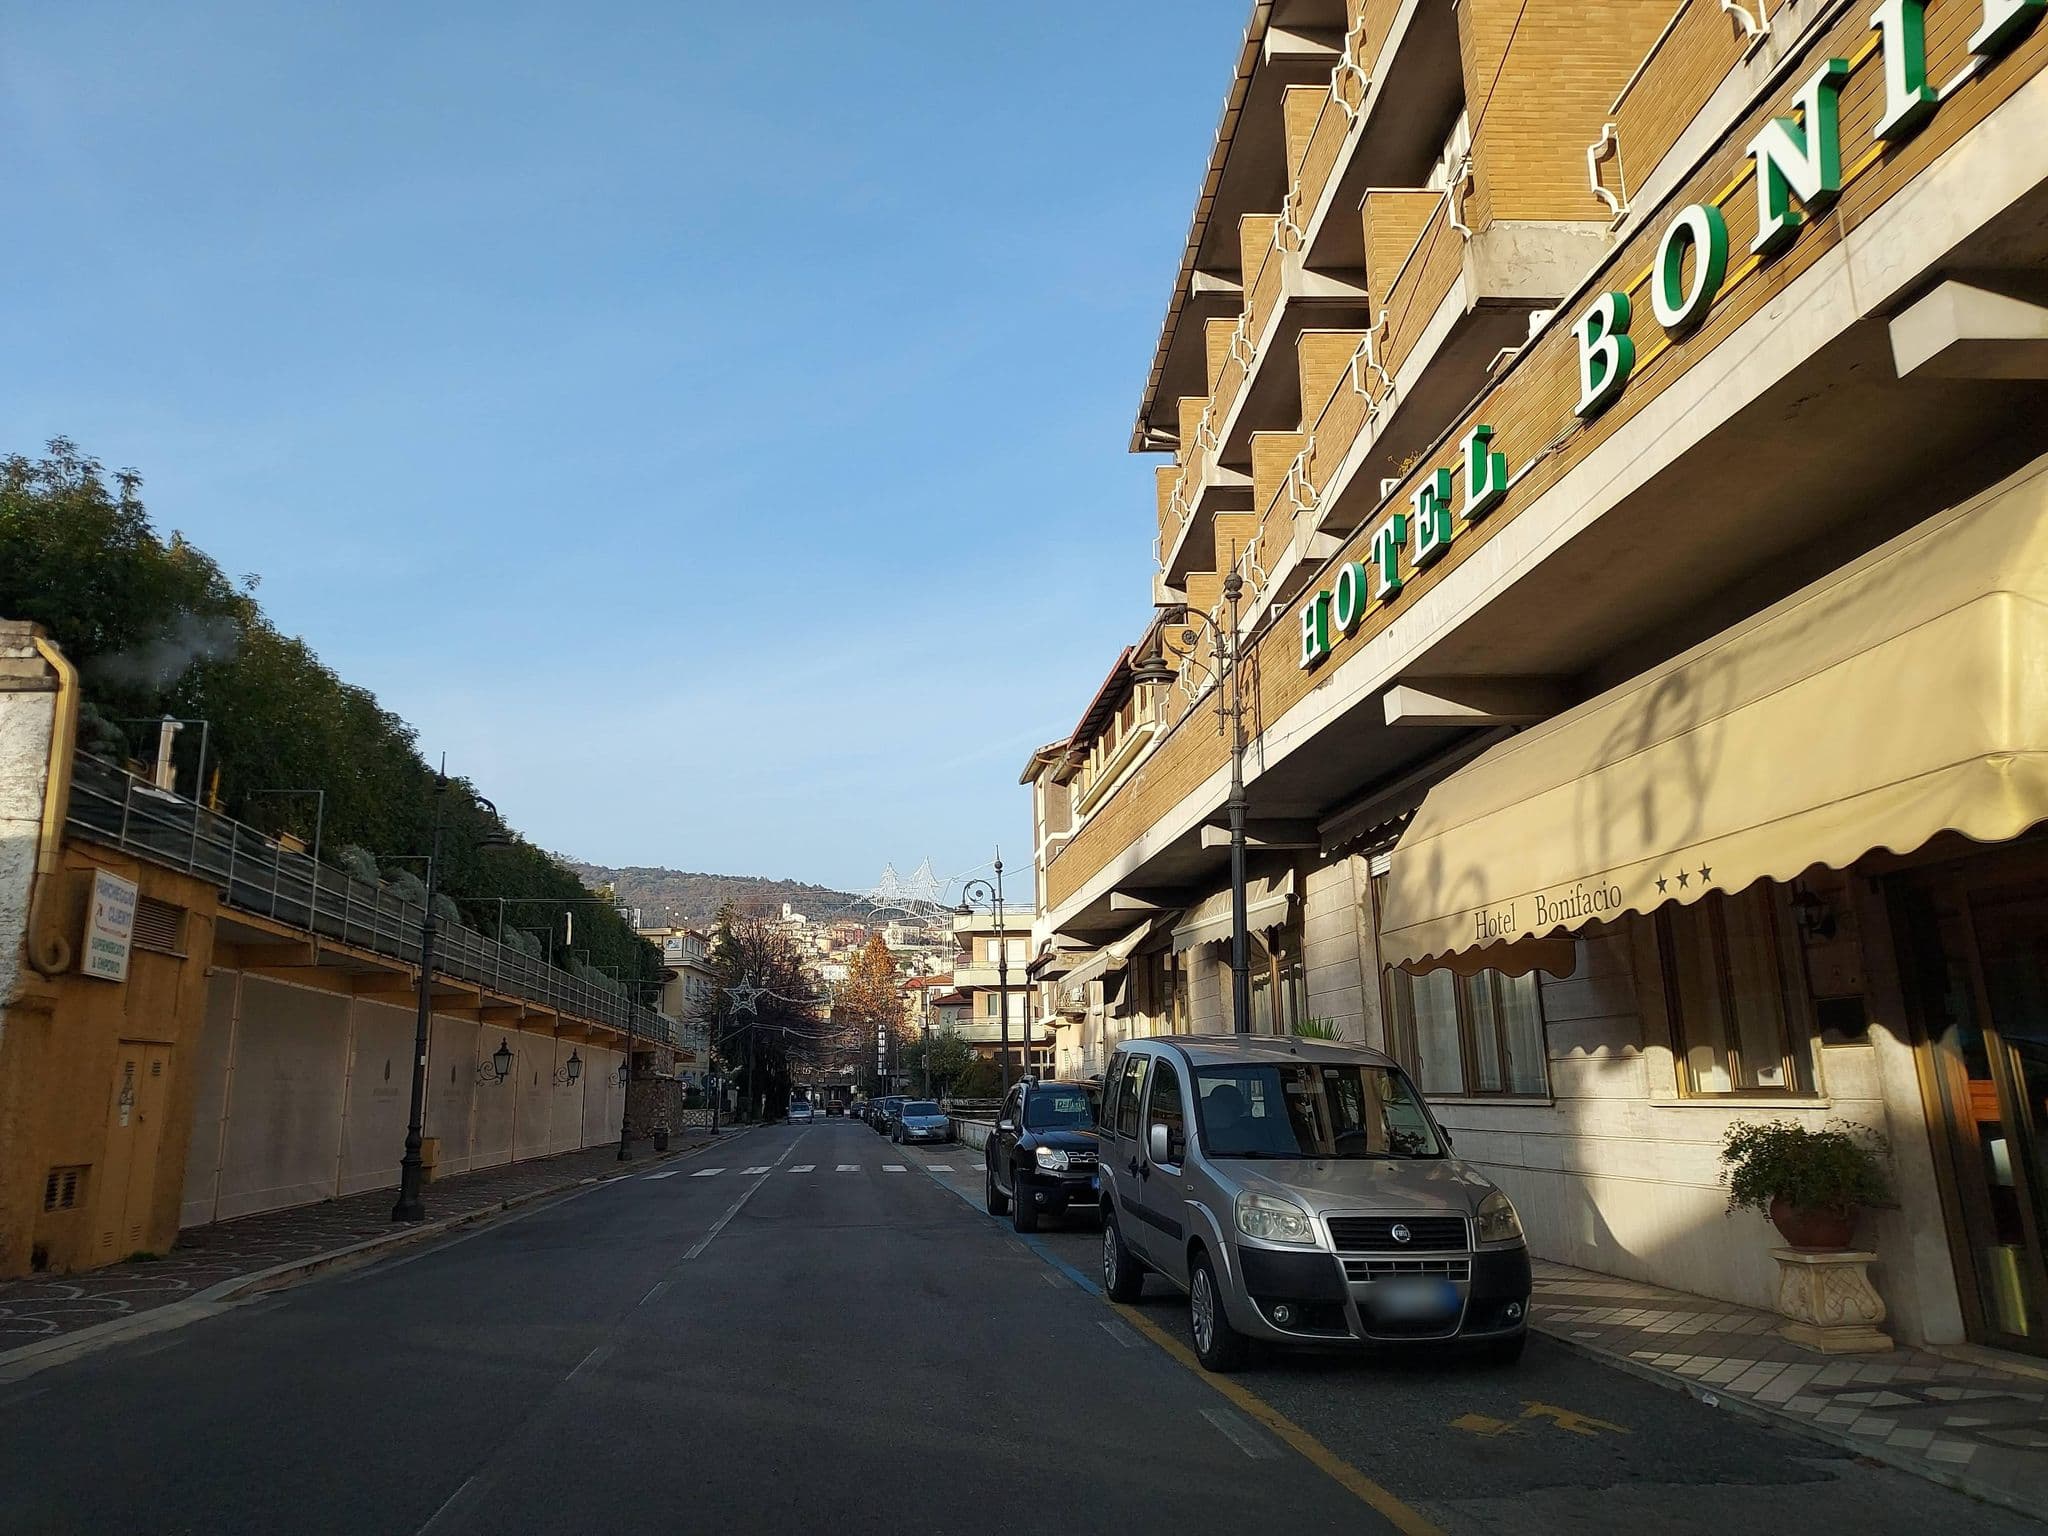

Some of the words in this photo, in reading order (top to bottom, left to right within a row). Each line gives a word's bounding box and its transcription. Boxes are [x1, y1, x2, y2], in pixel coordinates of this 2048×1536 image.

[1299, 424, 1507, 671] HOTEL
[1475, 903, 1516, 940] Hotel
[1534, 881, 1622, 926] Bonifacio
